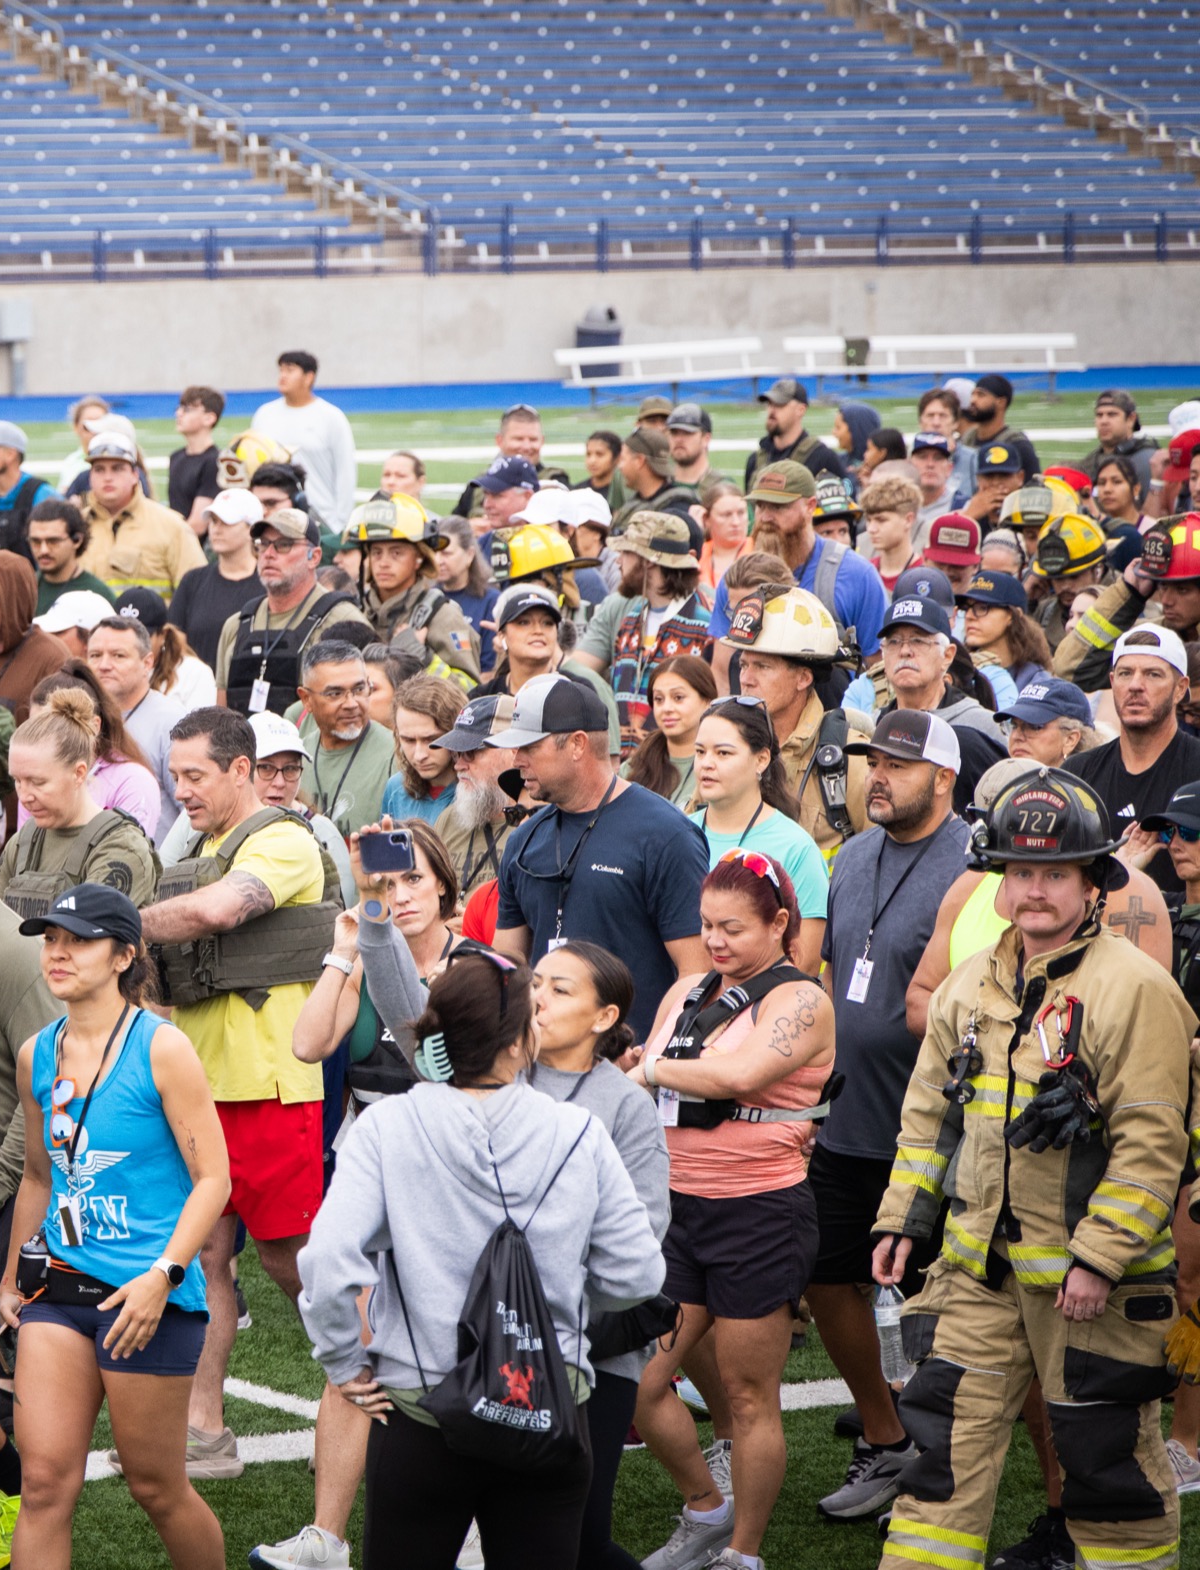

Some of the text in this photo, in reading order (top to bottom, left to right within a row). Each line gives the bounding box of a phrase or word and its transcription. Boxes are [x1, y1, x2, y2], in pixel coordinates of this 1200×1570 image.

[1144, 540, 1163, 556] 485
[120, 604, 139, 619] alo
[732, 613, 754, 632] 062
[1015, 791, 1065, 810] MIDLAND FIRE
[1018, 810, 1057, 834] 727
[1026, 837, 1046, 848] NUTT
[597, 863, 624, 876] Columbia
[89, 1195, 131, 1240] N
